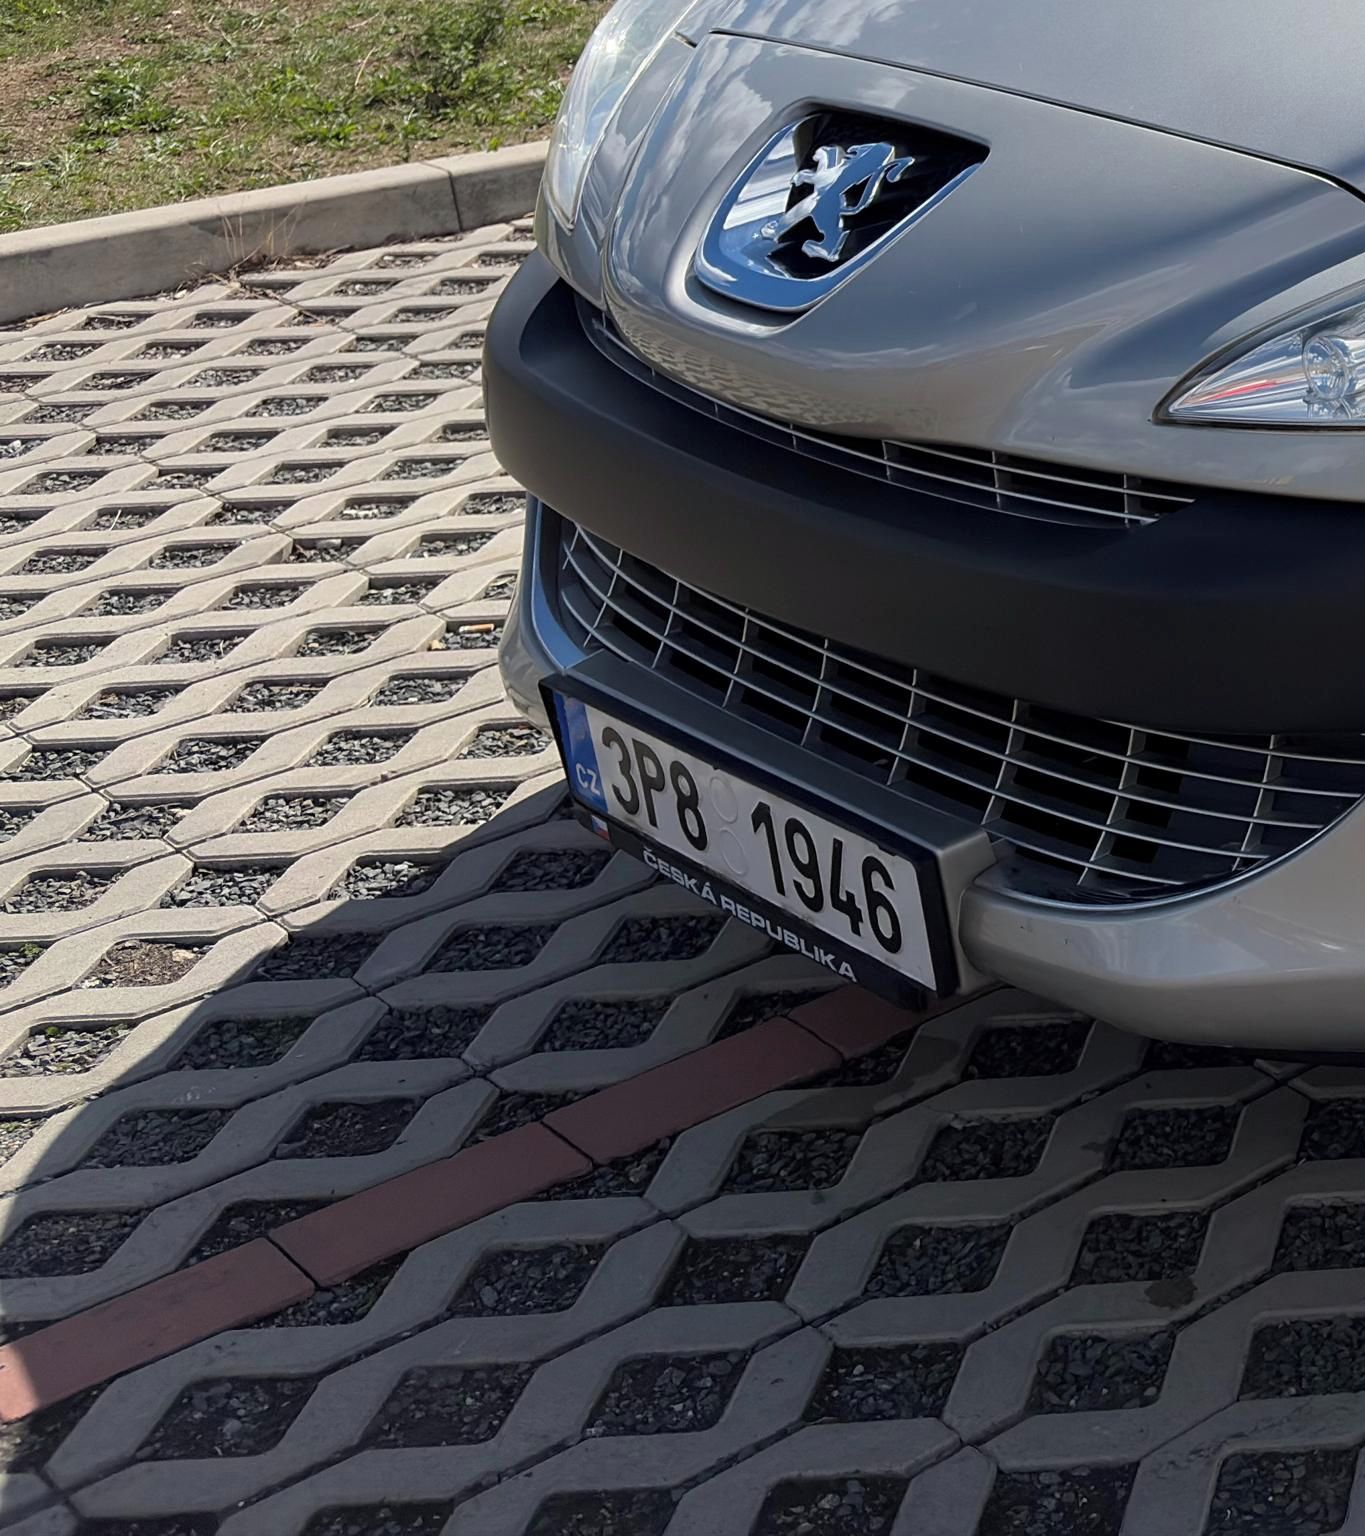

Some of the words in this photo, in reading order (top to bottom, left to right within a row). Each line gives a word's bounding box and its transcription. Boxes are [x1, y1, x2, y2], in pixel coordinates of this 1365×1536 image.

[576, 763, 600, 795] CZ
[602, 726, 708, 852] 3P8
[751, 801, 903, 955] 1946
[642, 848, 718, 905] ČESKÁ
[719, 894, 858, 983] REPUBLIKA
